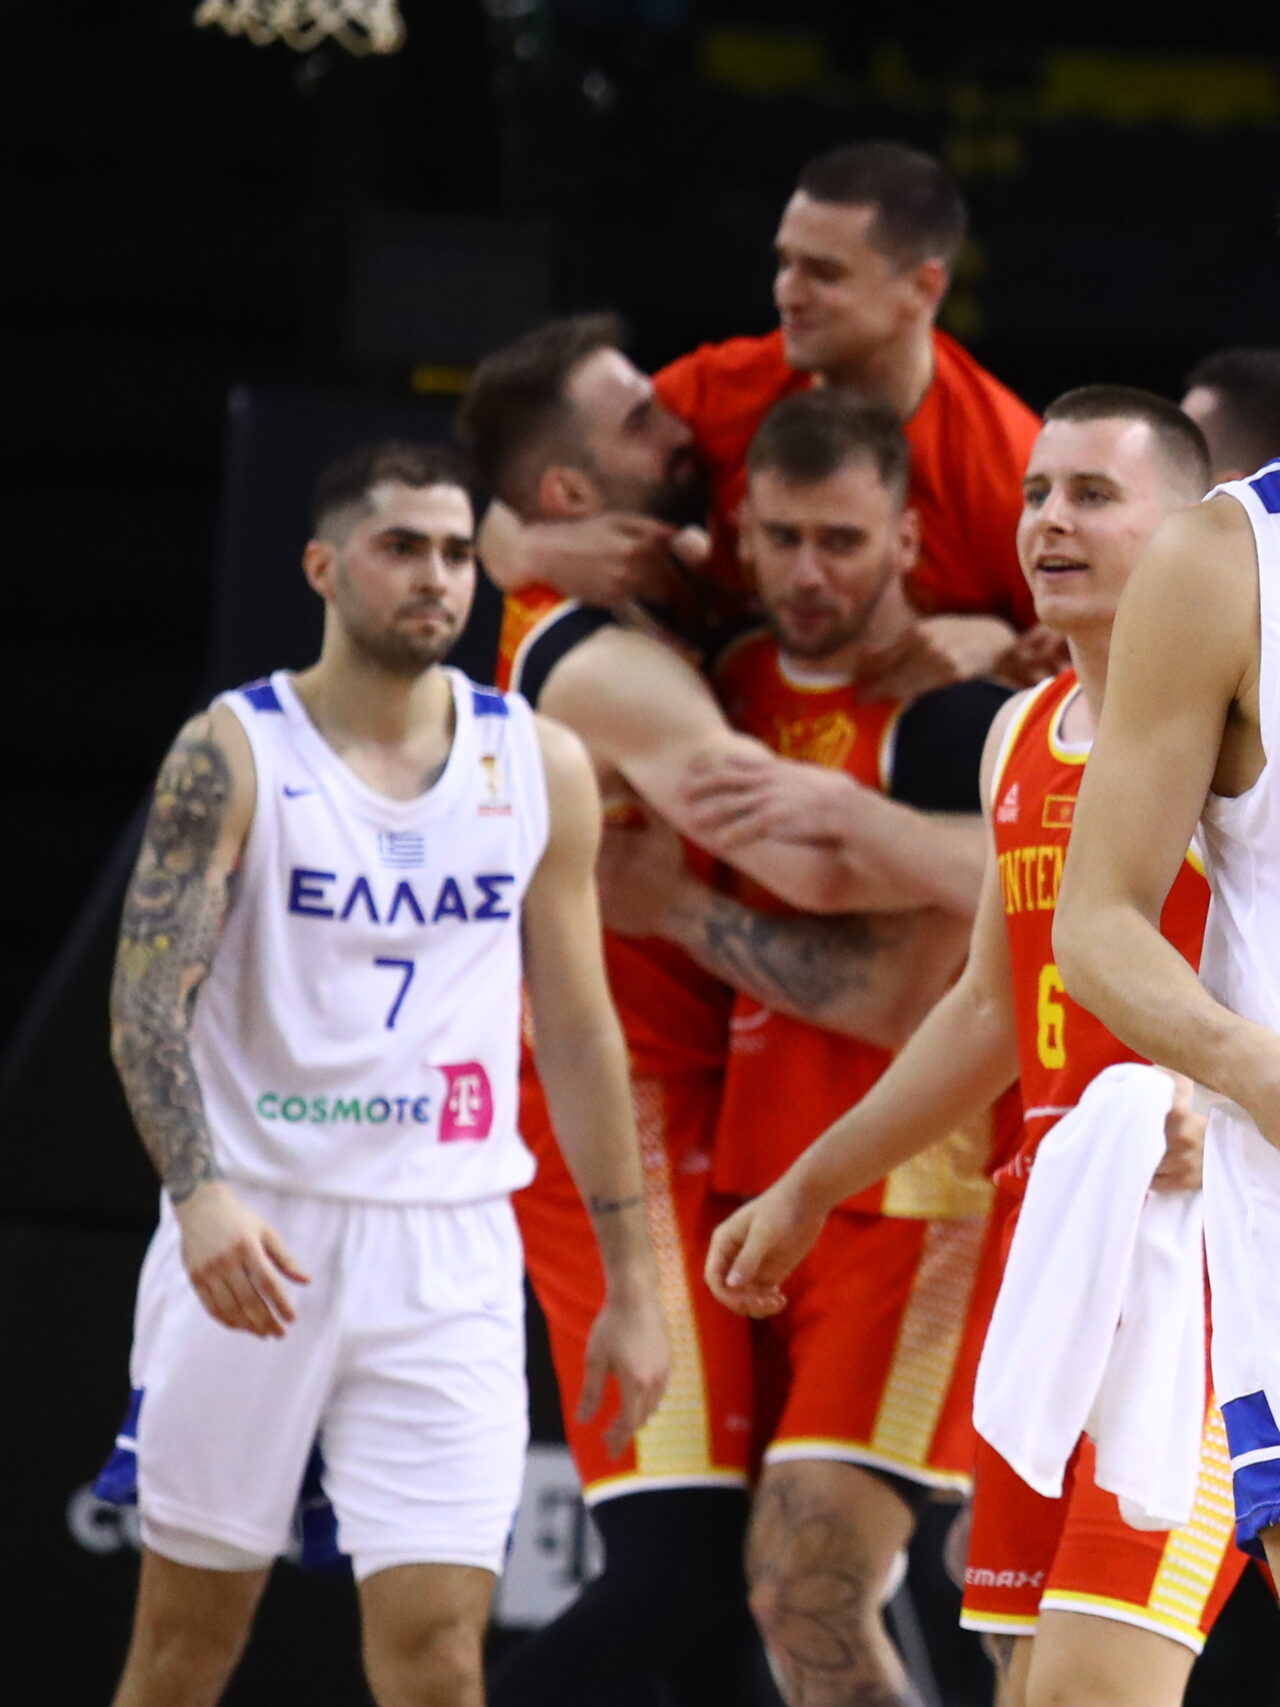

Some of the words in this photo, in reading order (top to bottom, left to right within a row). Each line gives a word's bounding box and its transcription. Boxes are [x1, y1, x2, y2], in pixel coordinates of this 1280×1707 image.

[288, 868, 515, 925] ΕΛΛΑΣ
[373, 957, 415, 1030] 7
[1037, 963, 1066, 1069] 6
[256, 1091, 430, 1125] COSMOTE
